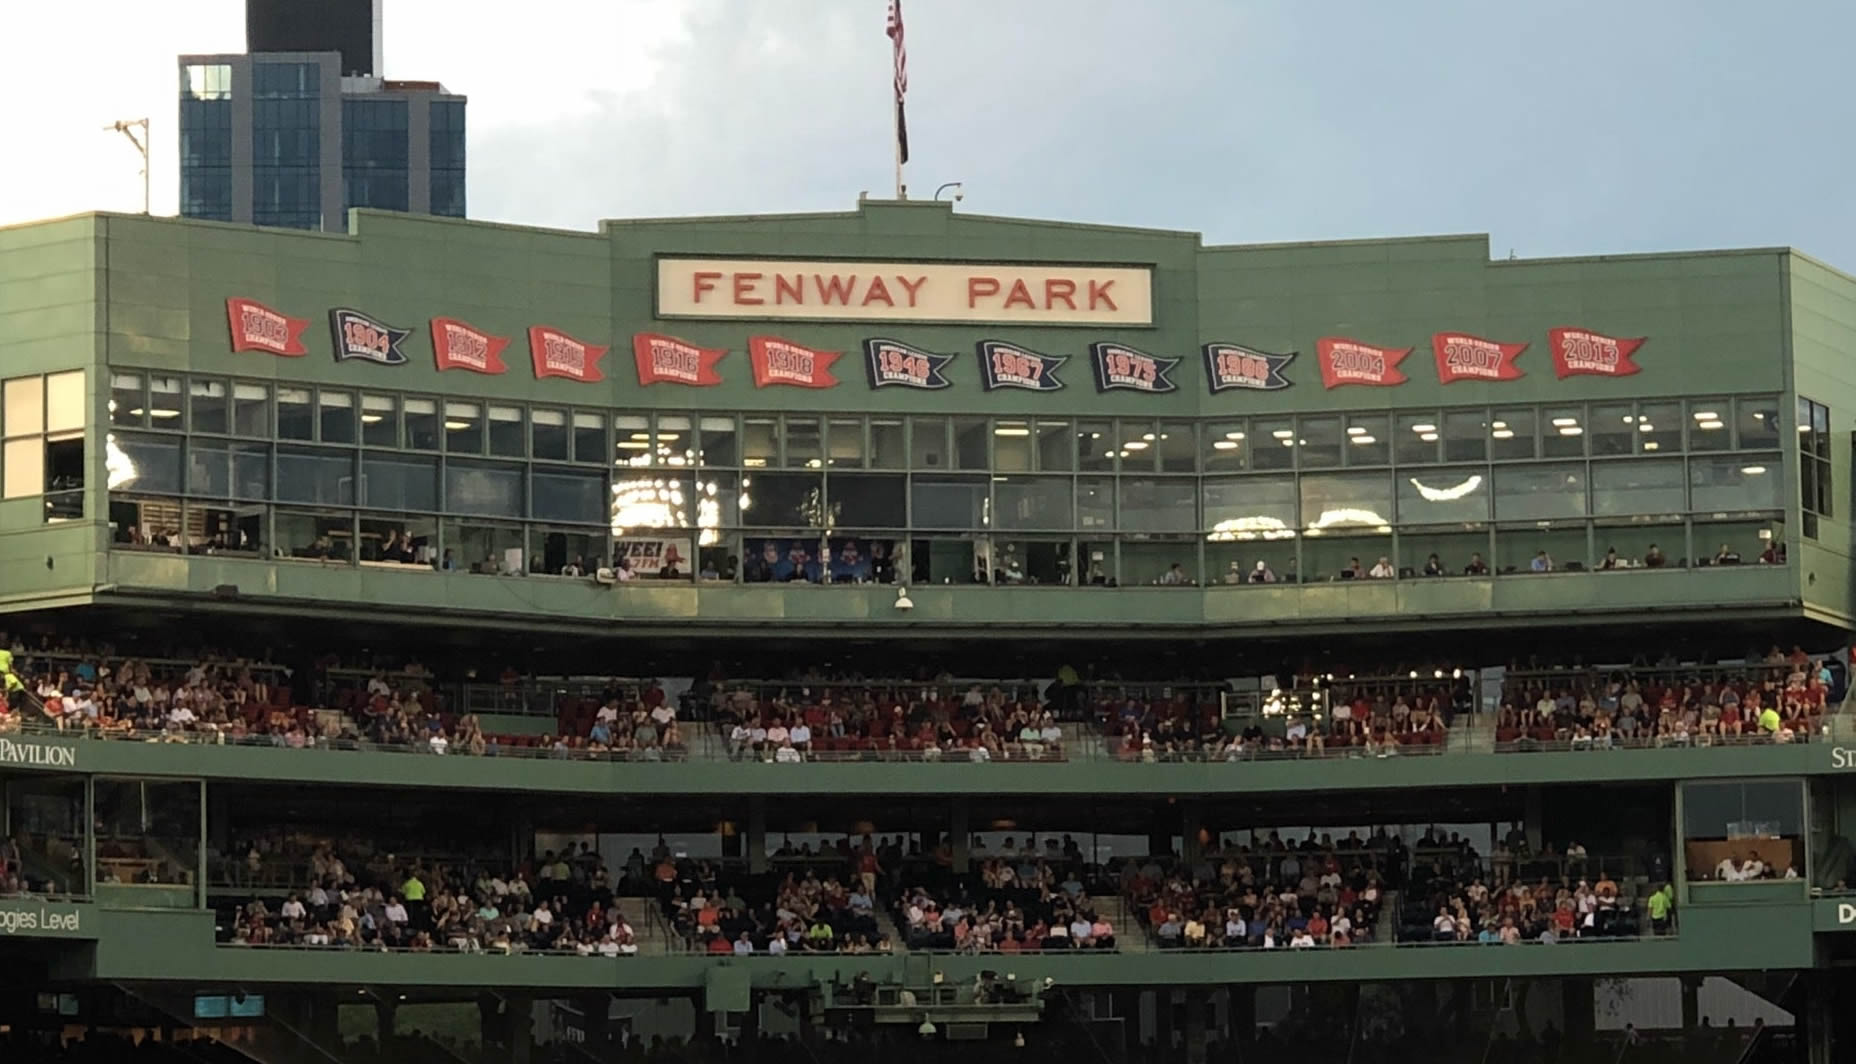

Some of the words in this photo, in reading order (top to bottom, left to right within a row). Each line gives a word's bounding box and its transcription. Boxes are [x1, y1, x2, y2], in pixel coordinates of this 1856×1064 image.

[693, 271, 927, 308] FENWAY
[967, 276, 1118, 311] PARK
[344, 322, 389, 354] 1904
[447, 331, 488, 361] 1912
[651, 346, 700, 374] 1916
[767, 348, 815, 376] 1918
[879, 351, 930, 378] 1946
[1329, 350, 1385, 376] 2004
[1444, 344, 1503, 370] 2007
[1562, 339, 1619, 365] 2013
[992, 353, 1043, 380] 1967
[1106, 354, 1157, 382] 1975
[613, 541, 663, 559] WEEI
[0, 738, 75, 767] PAVILION
[1832, 746, 1856, 768] ST
[41, 908, 79, 931] Level
[1838, 903, 1856, 923] D
